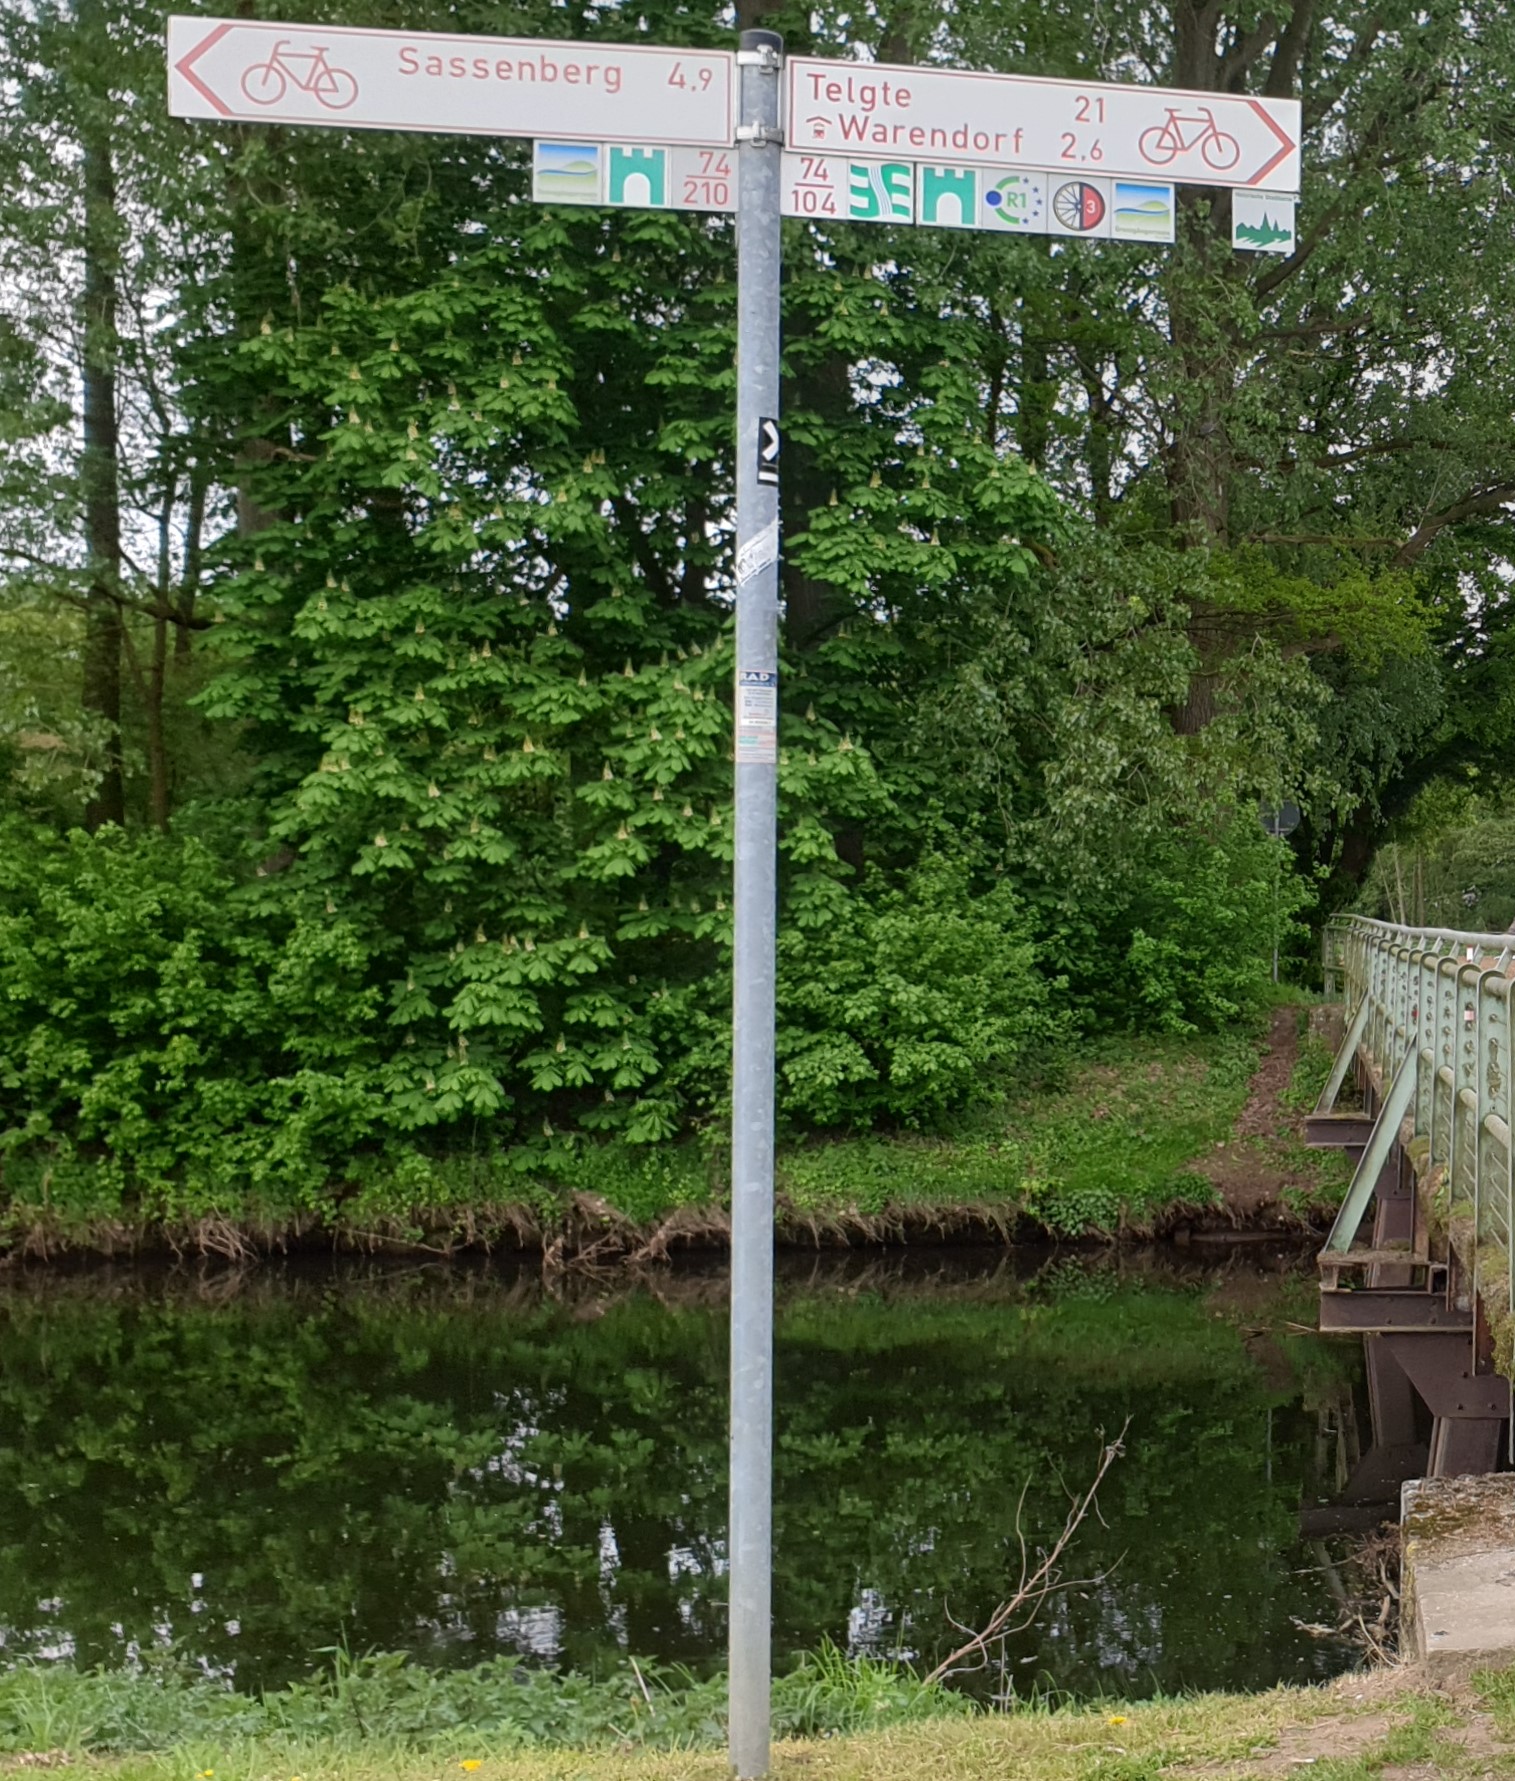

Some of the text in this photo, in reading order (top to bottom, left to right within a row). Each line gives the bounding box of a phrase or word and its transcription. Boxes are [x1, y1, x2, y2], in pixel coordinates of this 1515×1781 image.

[398, 46, 622, 93] Sassenberg
[806, 72, 1105, 124] Telgte 21
[838, 113, 1104, 162] Warendorf 2,6
[699, 150, 731, 177] 74
[800, 157, 829, 182] 74
[683, 181, 729, 206] 210
[791, 189, 837, 215] 104
[1006, 191, 1027, 209] R1
[1086, 200, 1097, 215] 3
